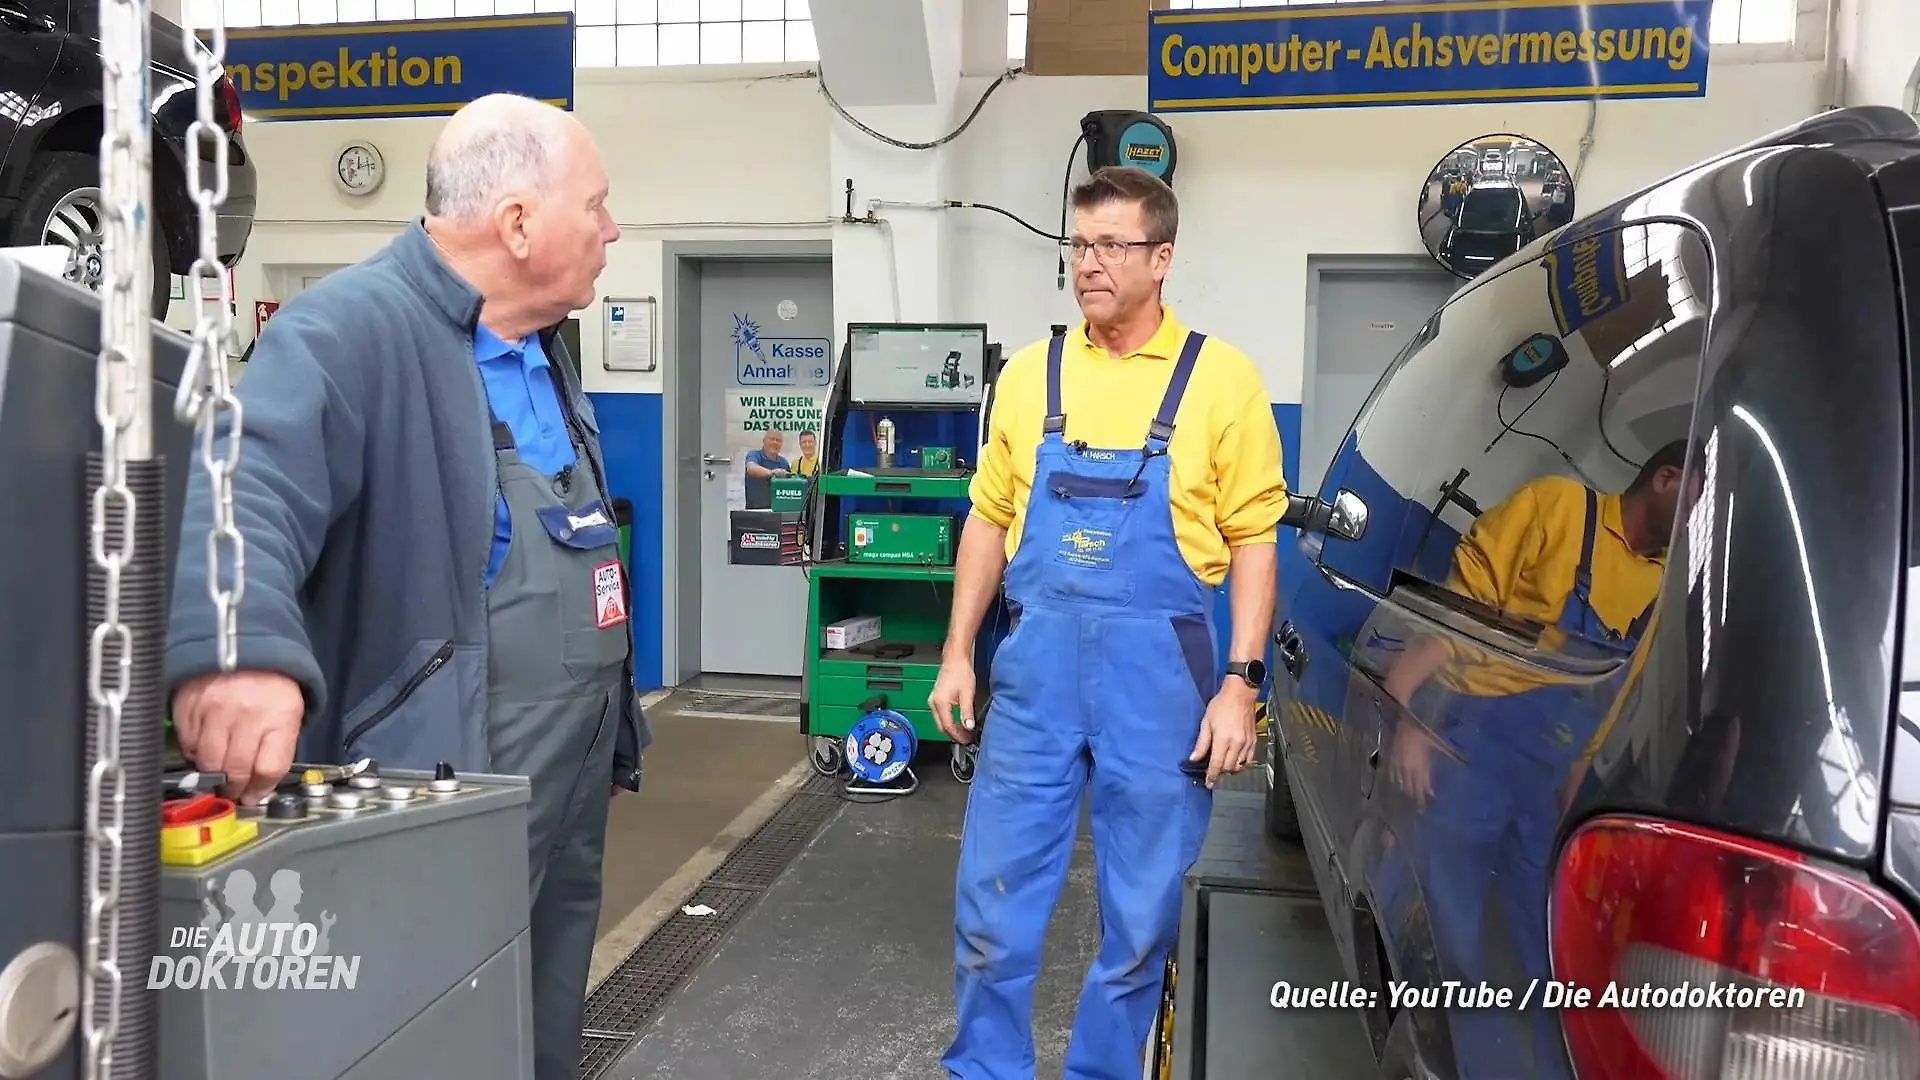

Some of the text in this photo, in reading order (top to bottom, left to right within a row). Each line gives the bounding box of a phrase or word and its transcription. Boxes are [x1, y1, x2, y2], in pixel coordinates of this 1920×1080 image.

[1129, 147, 1160, 157] HAZET
[772, 343, 824, 358] Kasse
[740, 396, 813, 407] WIR LIEBEN
[749, 409, 793, 419] AUTOS
[743, 421, 770, 431] DAS
[776, 489, 802, 497] E-FUELS
